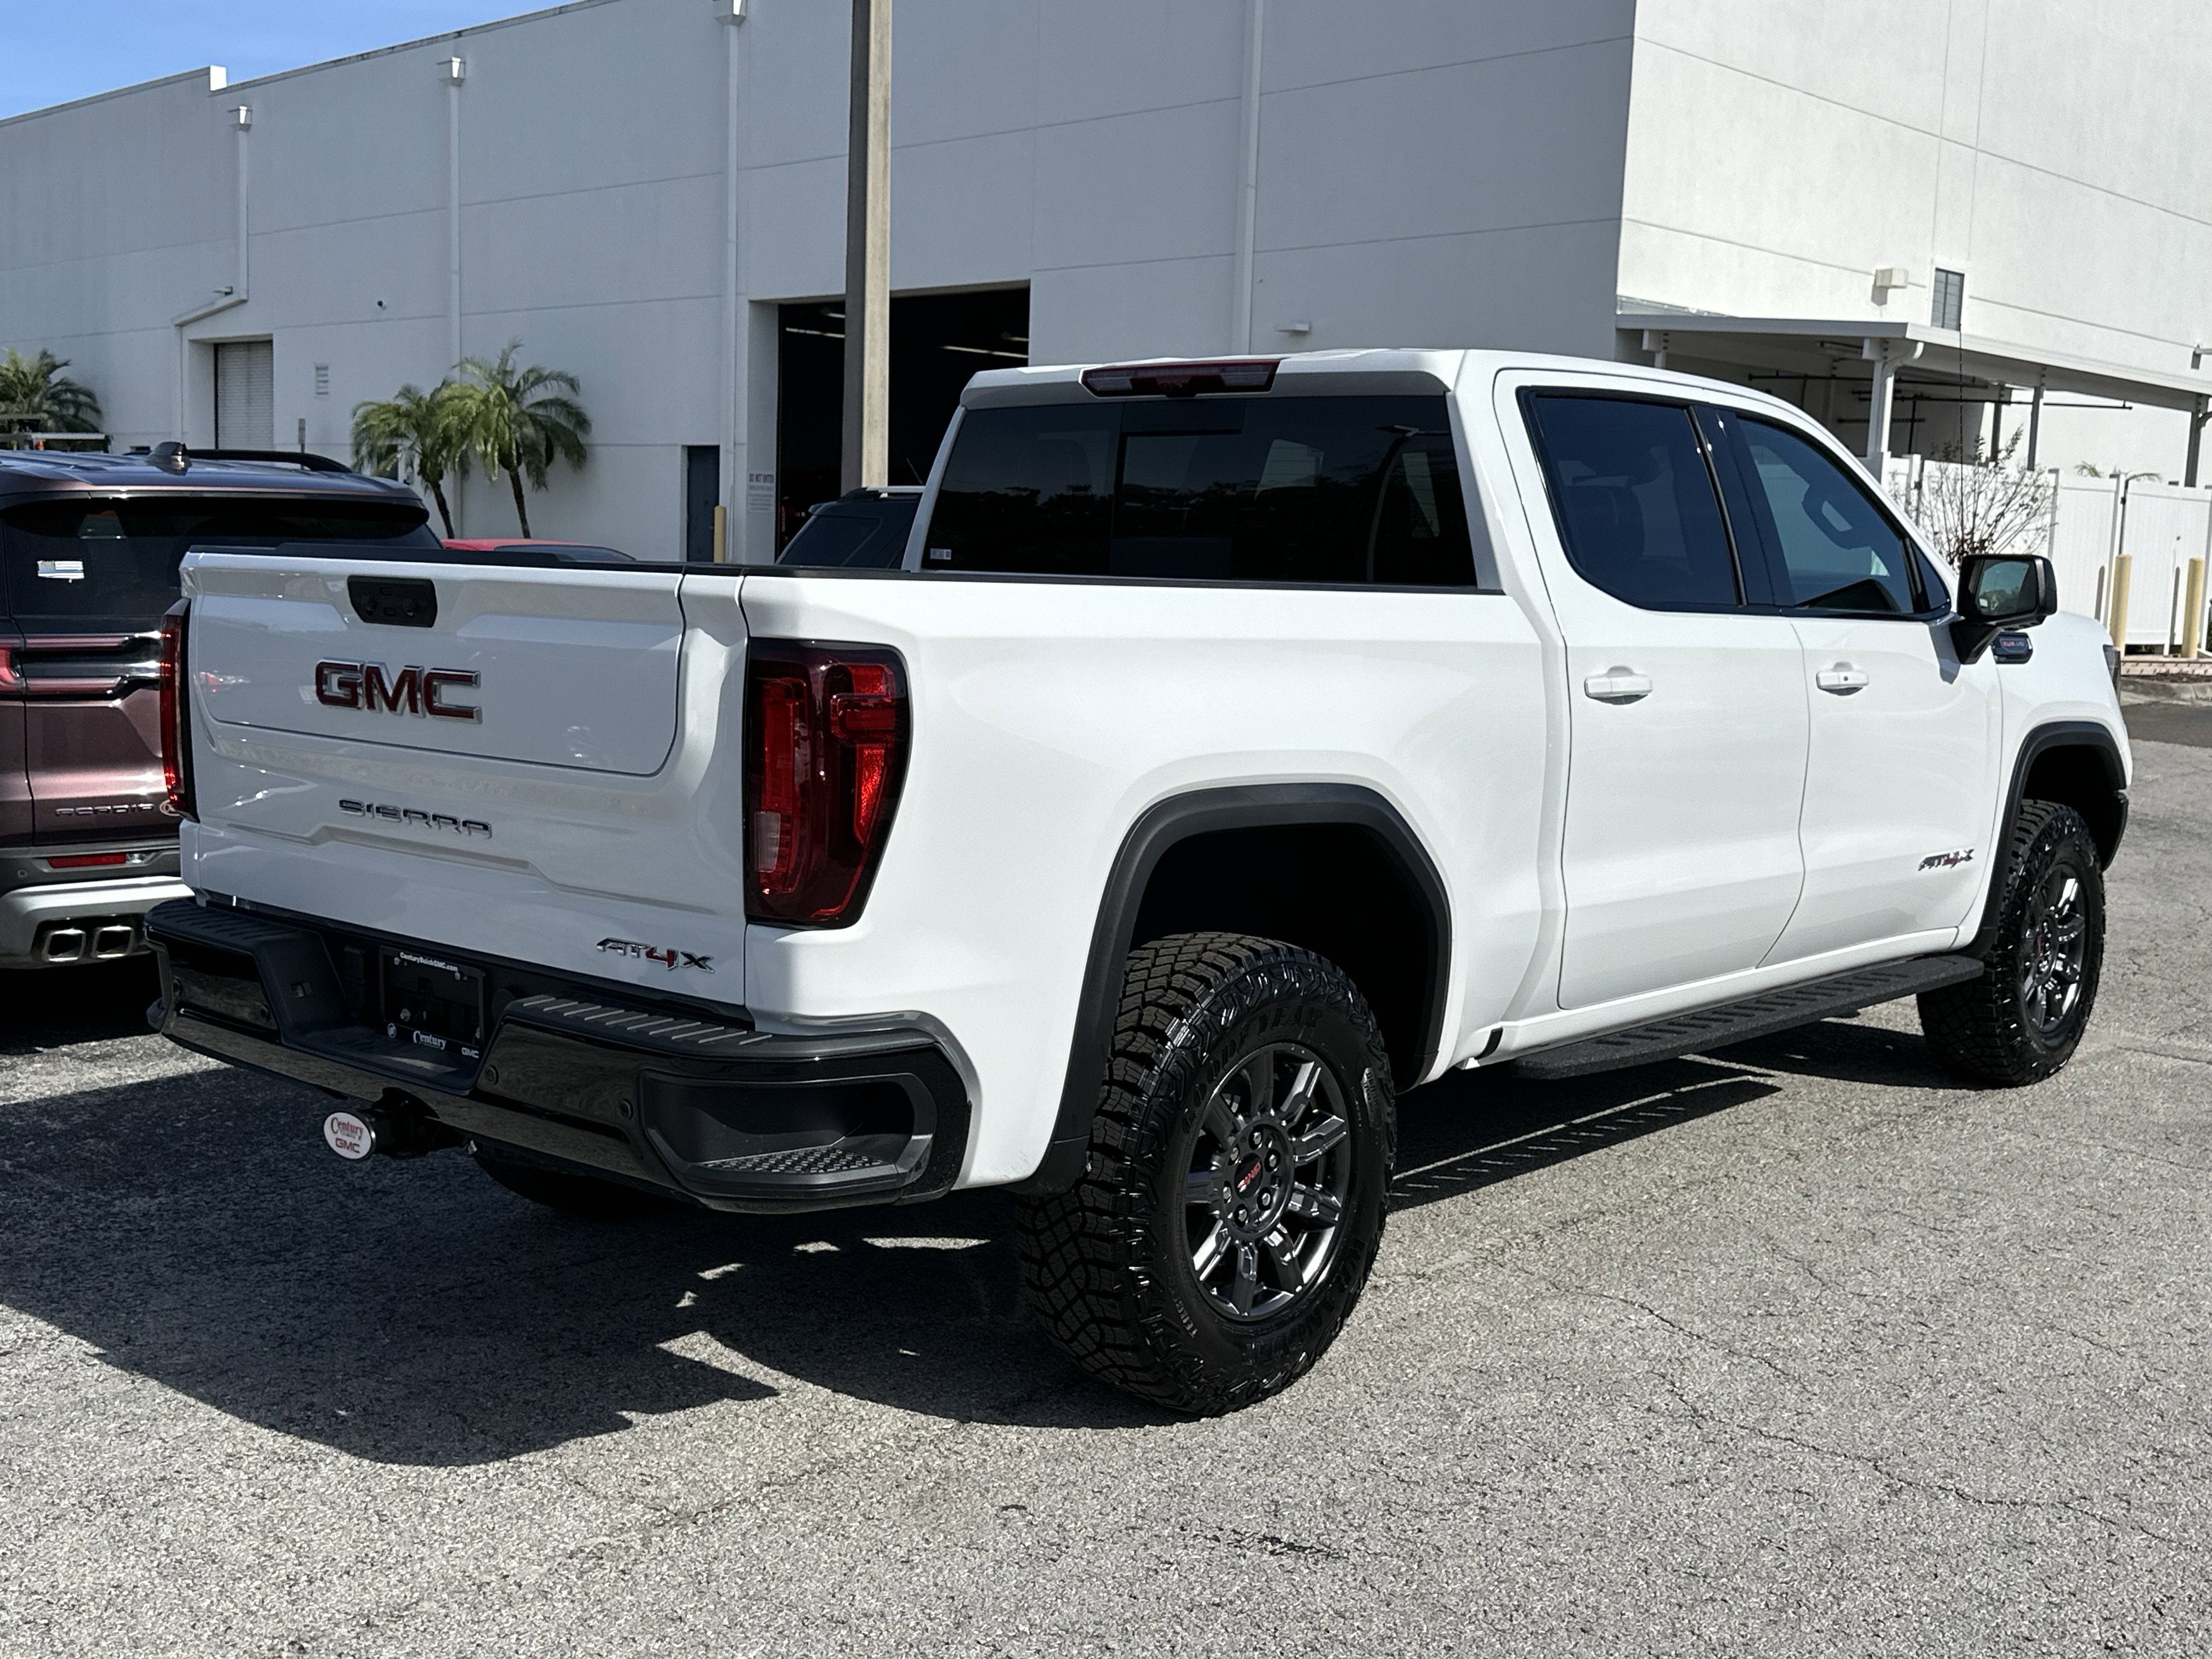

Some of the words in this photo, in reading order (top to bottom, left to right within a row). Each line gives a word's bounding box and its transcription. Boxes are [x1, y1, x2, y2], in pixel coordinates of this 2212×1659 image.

[315, 657, 483, 724] GMC
[55, 803, 155, 816] ACADIA
[338, 797, 492, 838] SIERRA
[1918, 849, 1974, 871] AT4X
[596, 937, 715, 973] AT4X
[413, 1030, 447, 1050] Century
[461, 1047, 479, 1059] GMC
[331, 1117, 363, 1141] Century
[335, 1138, 360, 1153] GMC
